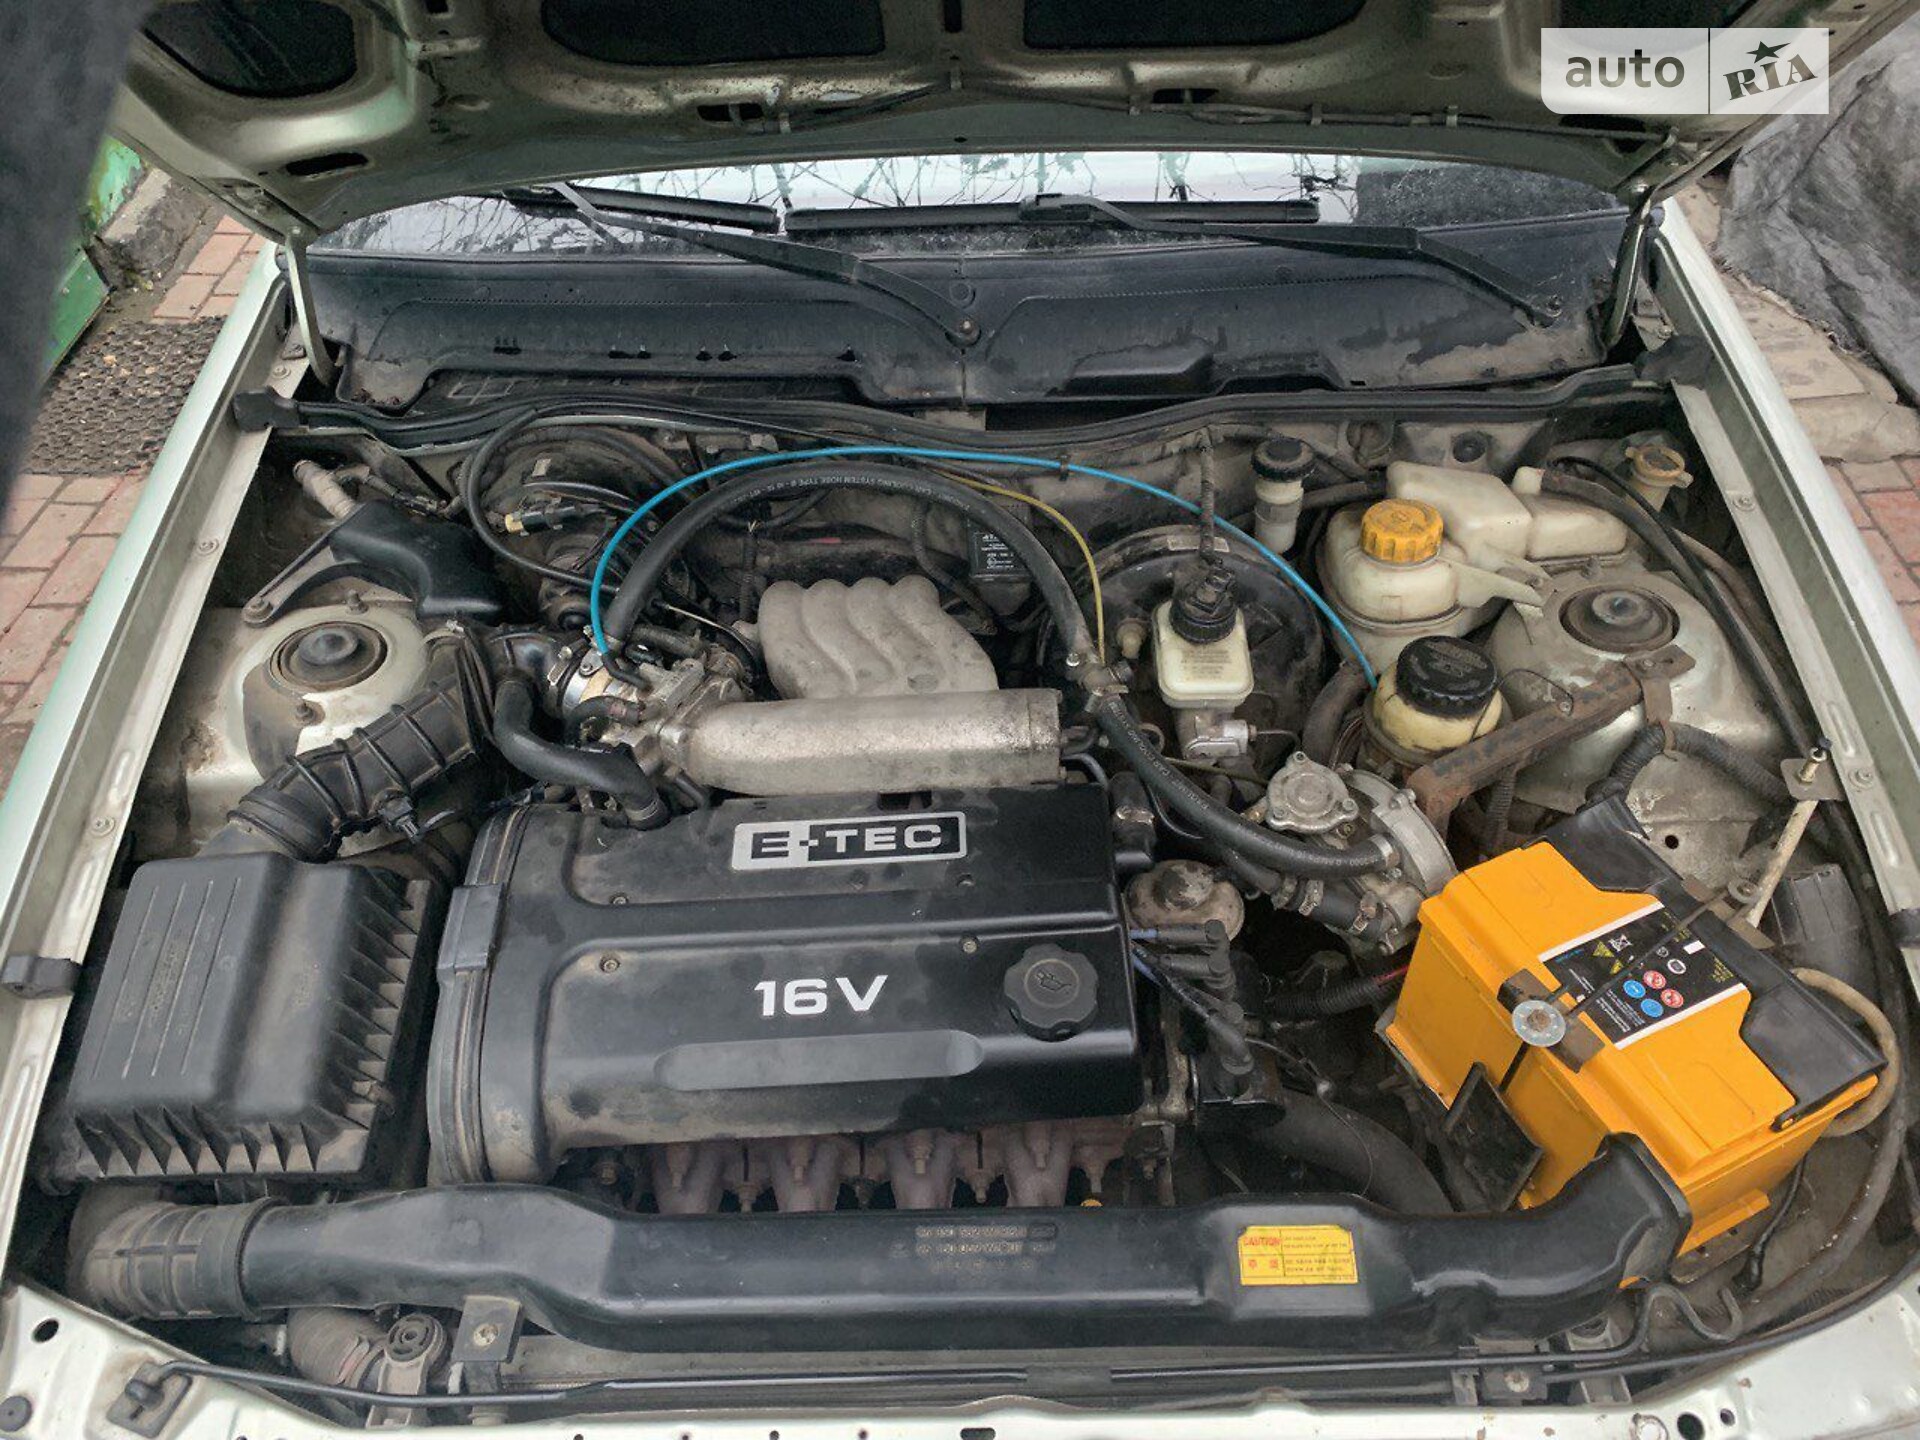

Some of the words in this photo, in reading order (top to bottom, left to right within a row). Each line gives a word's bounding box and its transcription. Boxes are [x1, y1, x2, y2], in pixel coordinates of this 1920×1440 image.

[751, 824, 942, 860] E-TEC
[754, 975, 889, 1016] 16V
[1243, 1236, 1280, 1247] CAUTION
